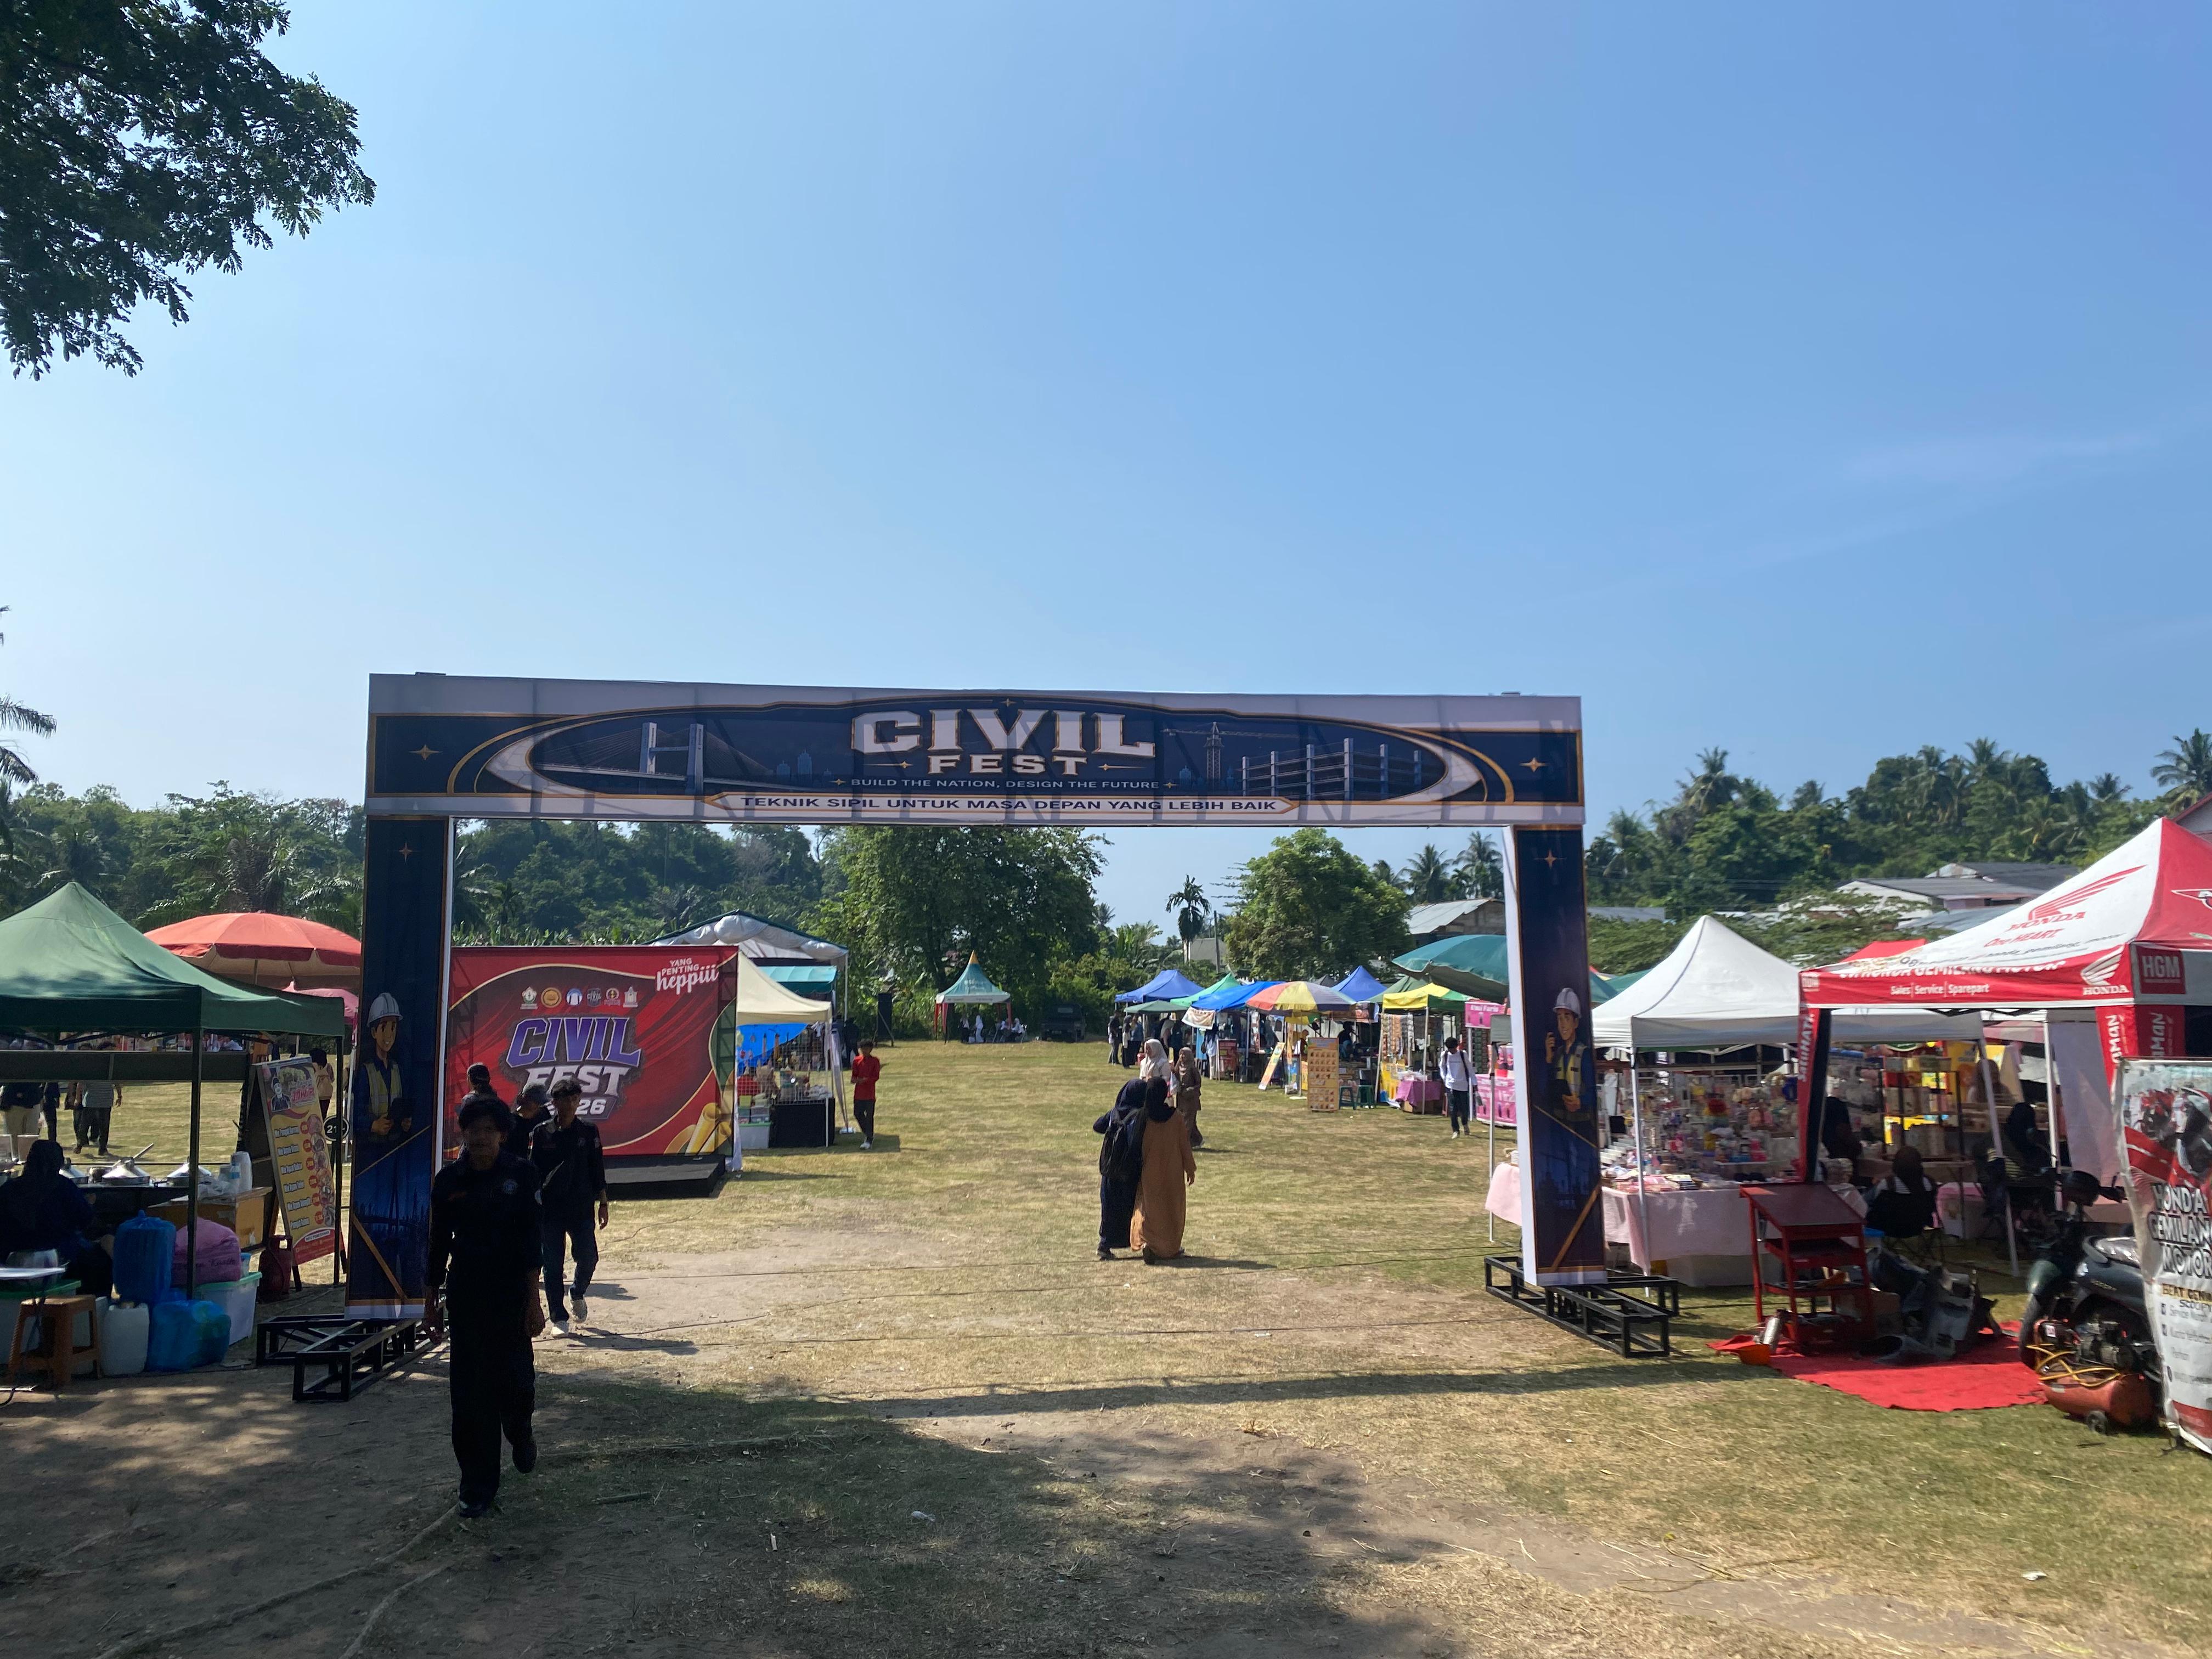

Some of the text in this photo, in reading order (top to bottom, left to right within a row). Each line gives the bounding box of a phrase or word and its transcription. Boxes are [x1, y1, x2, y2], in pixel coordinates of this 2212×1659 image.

[852, 709, 1155, 757] CIVIL
[928, 754, 1087, 775] FEST
[936, 780, 1000, 788] NATION,
[741, 798, 1276, 810] TEKNIK SIPIL UNTUK MASA DEPAN YANG LEBIH BAIK
[2004, 912, 2086, 932] HONDA
[662, 964, 699, 976] PENTING
[669, 958, 692, 967] YANG
[2141, 956, 2181, 977] HGM
[656, 964, 719, 995] heppiii
[1891, 984, 1990, 996] Sales Service Sparepart
[2083, 985, 2129, 995] HONDA
[506, 1017, 641, 1068] CIVIL
[2151, 1182, 2207, 1214] HONDA
[2147, 1211, 2212, 1249] GEMILAN
